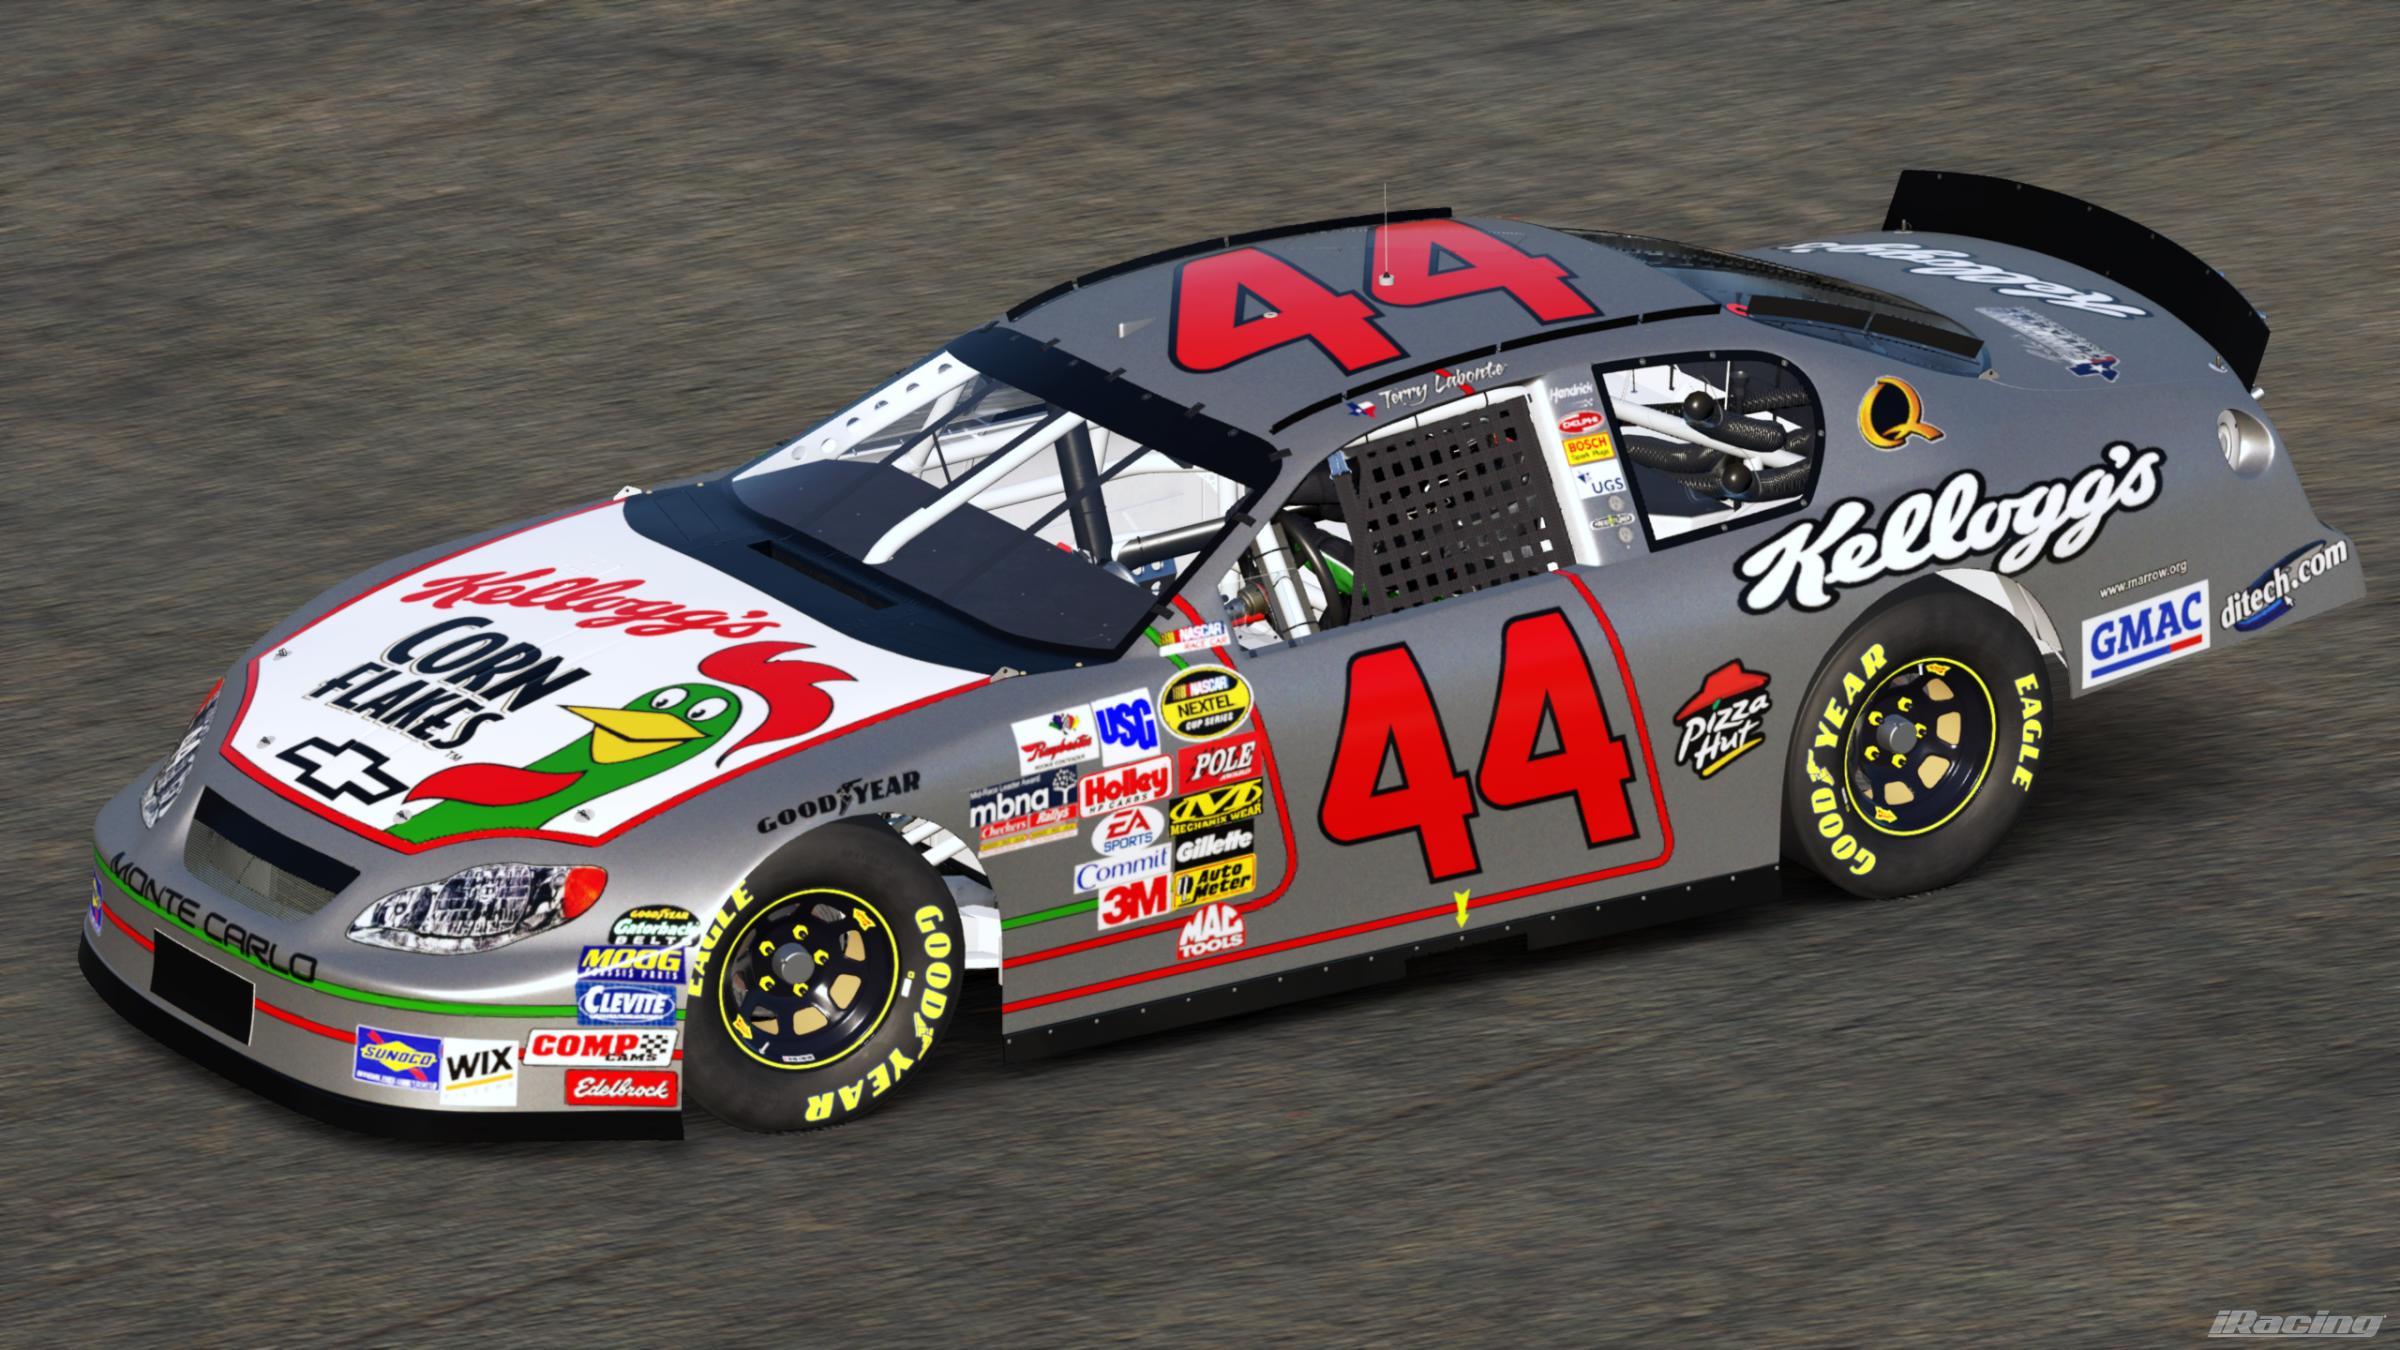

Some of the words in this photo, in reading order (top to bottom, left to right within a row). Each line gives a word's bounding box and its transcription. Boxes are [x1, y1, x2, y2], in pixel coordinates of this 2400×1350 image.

[1168, 218, 1605, 376] 44
[1379, 383, 1428, 410] Terry
[1435, 361, 1508, 394] Labonte
[1549, 381, 1593, 404] Hendrick
[1567, 437, 1608, 453] BOSCH
[1591, 478, 1624, 495] UGS
[1737, 441, 2167, 616] Kellogg's
[2099, 560, 2188, 599] www.marrow.org
[2220, 540, 2348, 630] ditech.com
[400, 567, 781, 639] Kellogg's
[1179, 621, 1226, 641] NASCAR
[1209, 637, 1227, 647] CAR
[2091, 591, 2203, 661] GMAC
[380, 616, 592, 714] CORN
[302, 661, 505, 750] FLAKES
[1189, 675, 1229, 697] NASCAR
[1095, 698, 1158, 751] USG
[1177, 694, 1235, 718] NEXTEL
[1185, 718, 1203, 732] CUP
[1204, 712, 1234, 728] SERIES
[1318, 606, 1640, 884] 44
[1678, 694, 1770, 763] Pizza
[1694, 720, 1760, 770] Hut
[2011, 673, 2043, 792] EAGLE
[1191, 740, 1257, 782] POLE
[757, 770, 921, 834] GOODYEAR
[1085, 764, 1168, 808] Holley
[1109, 793, 1149, 810] CARBS
[970, 787, 1049, 828] mbna
[1107, 808, 1151, 840] EA
[1230, 803, 1262, 821] WEAR
[1104, 831, 1153, 853] SPORTS
[1176, 828, 1254, 863] Gillette
[1076, 847, 1168, 890] Commit
[1199, 862, 1243, 884] Auto
[110, 851, 200, 928] MONTE
[1102, 875, 1168, 926] 3M
[1194, 875, 1251, 903] Meter
[688, 879, 754, 997] EAGLE
[1179, 903, 1244, 946] MAC
[204, 912, 318, 983] CARLO
[581, 948, 683, 972] MOOG
[1179, 934, 1244, 958] TOOLS
[584, 985, 672, 1014] CLEVITE
[364, 1045, 434, 1067] SUNOCO
[446, 1046, 513, 1081] WIX
[532, 1034, 639, 1057] COMP
[605, 1053, 658, 1062] CAMS
[574, 1077, 669, 1099] Edelbrock
